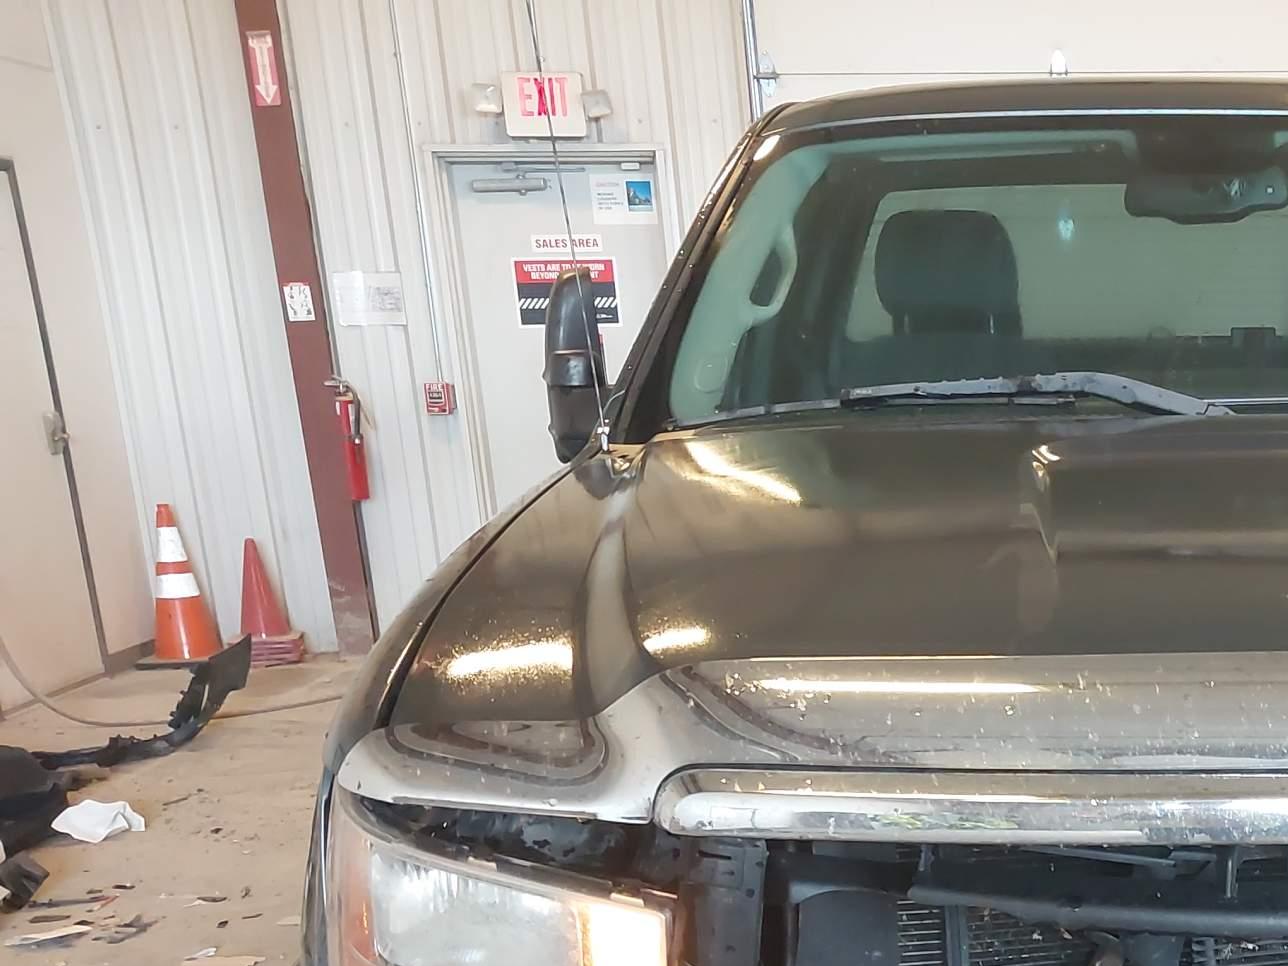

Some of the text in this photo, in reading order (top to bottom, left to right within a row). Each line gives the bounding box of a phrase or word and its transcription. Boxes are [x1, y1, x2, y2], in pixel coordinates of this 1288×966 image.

[516, 76, 568, 117] EXIT
[535, 238, 599, 249] SALES AREA
[425, 383, 444, 392] FIRE
